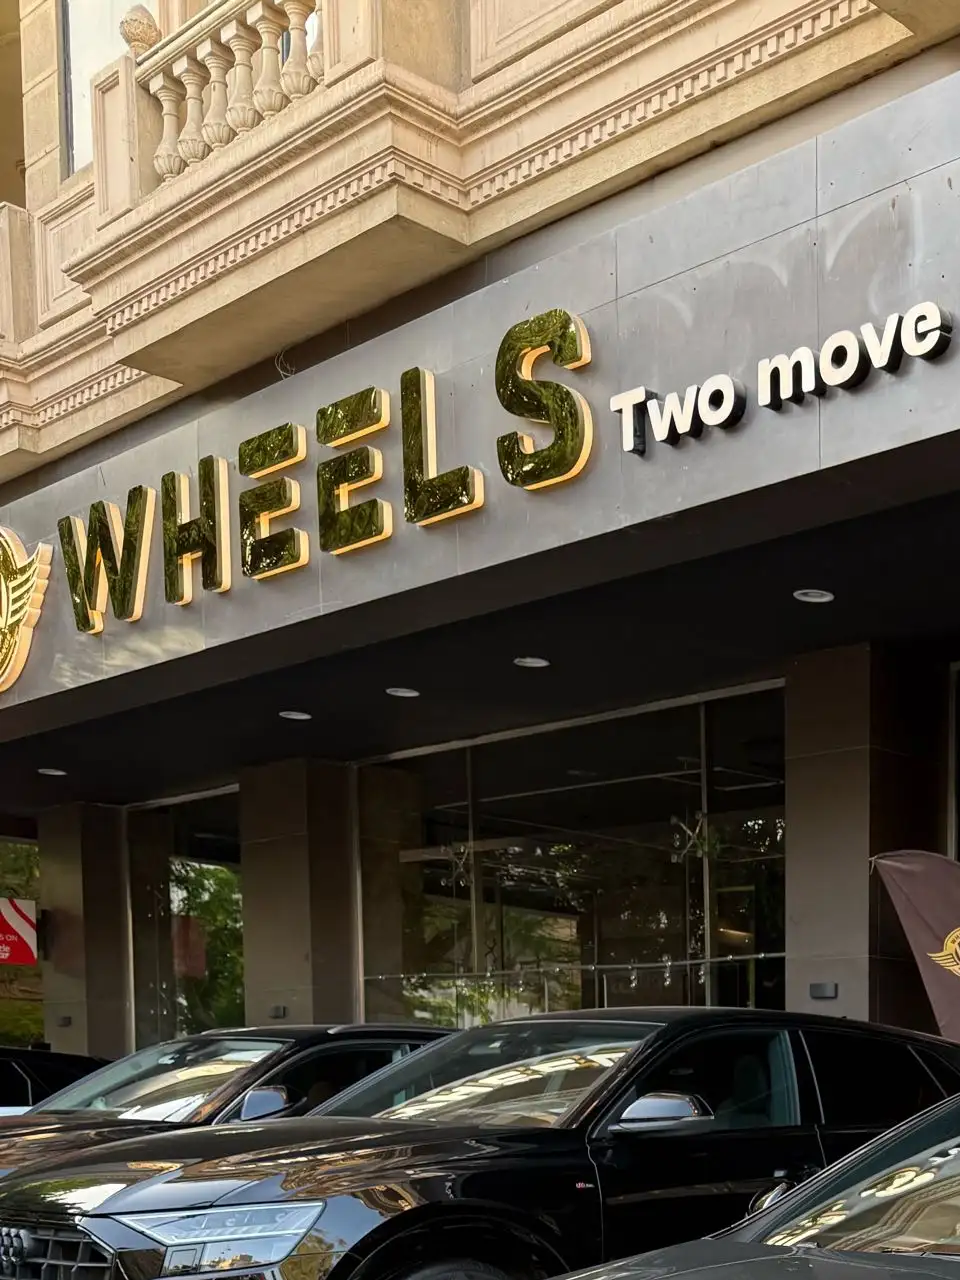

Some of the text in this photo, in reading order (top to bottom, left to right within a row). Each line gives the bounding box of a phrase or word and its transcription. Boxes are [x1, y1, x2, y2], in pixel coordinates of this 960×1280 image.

[58, 308, 592, 635] WHEELS
[610, 373, 742, 454] Two
[758, 301, 948, 409] move
